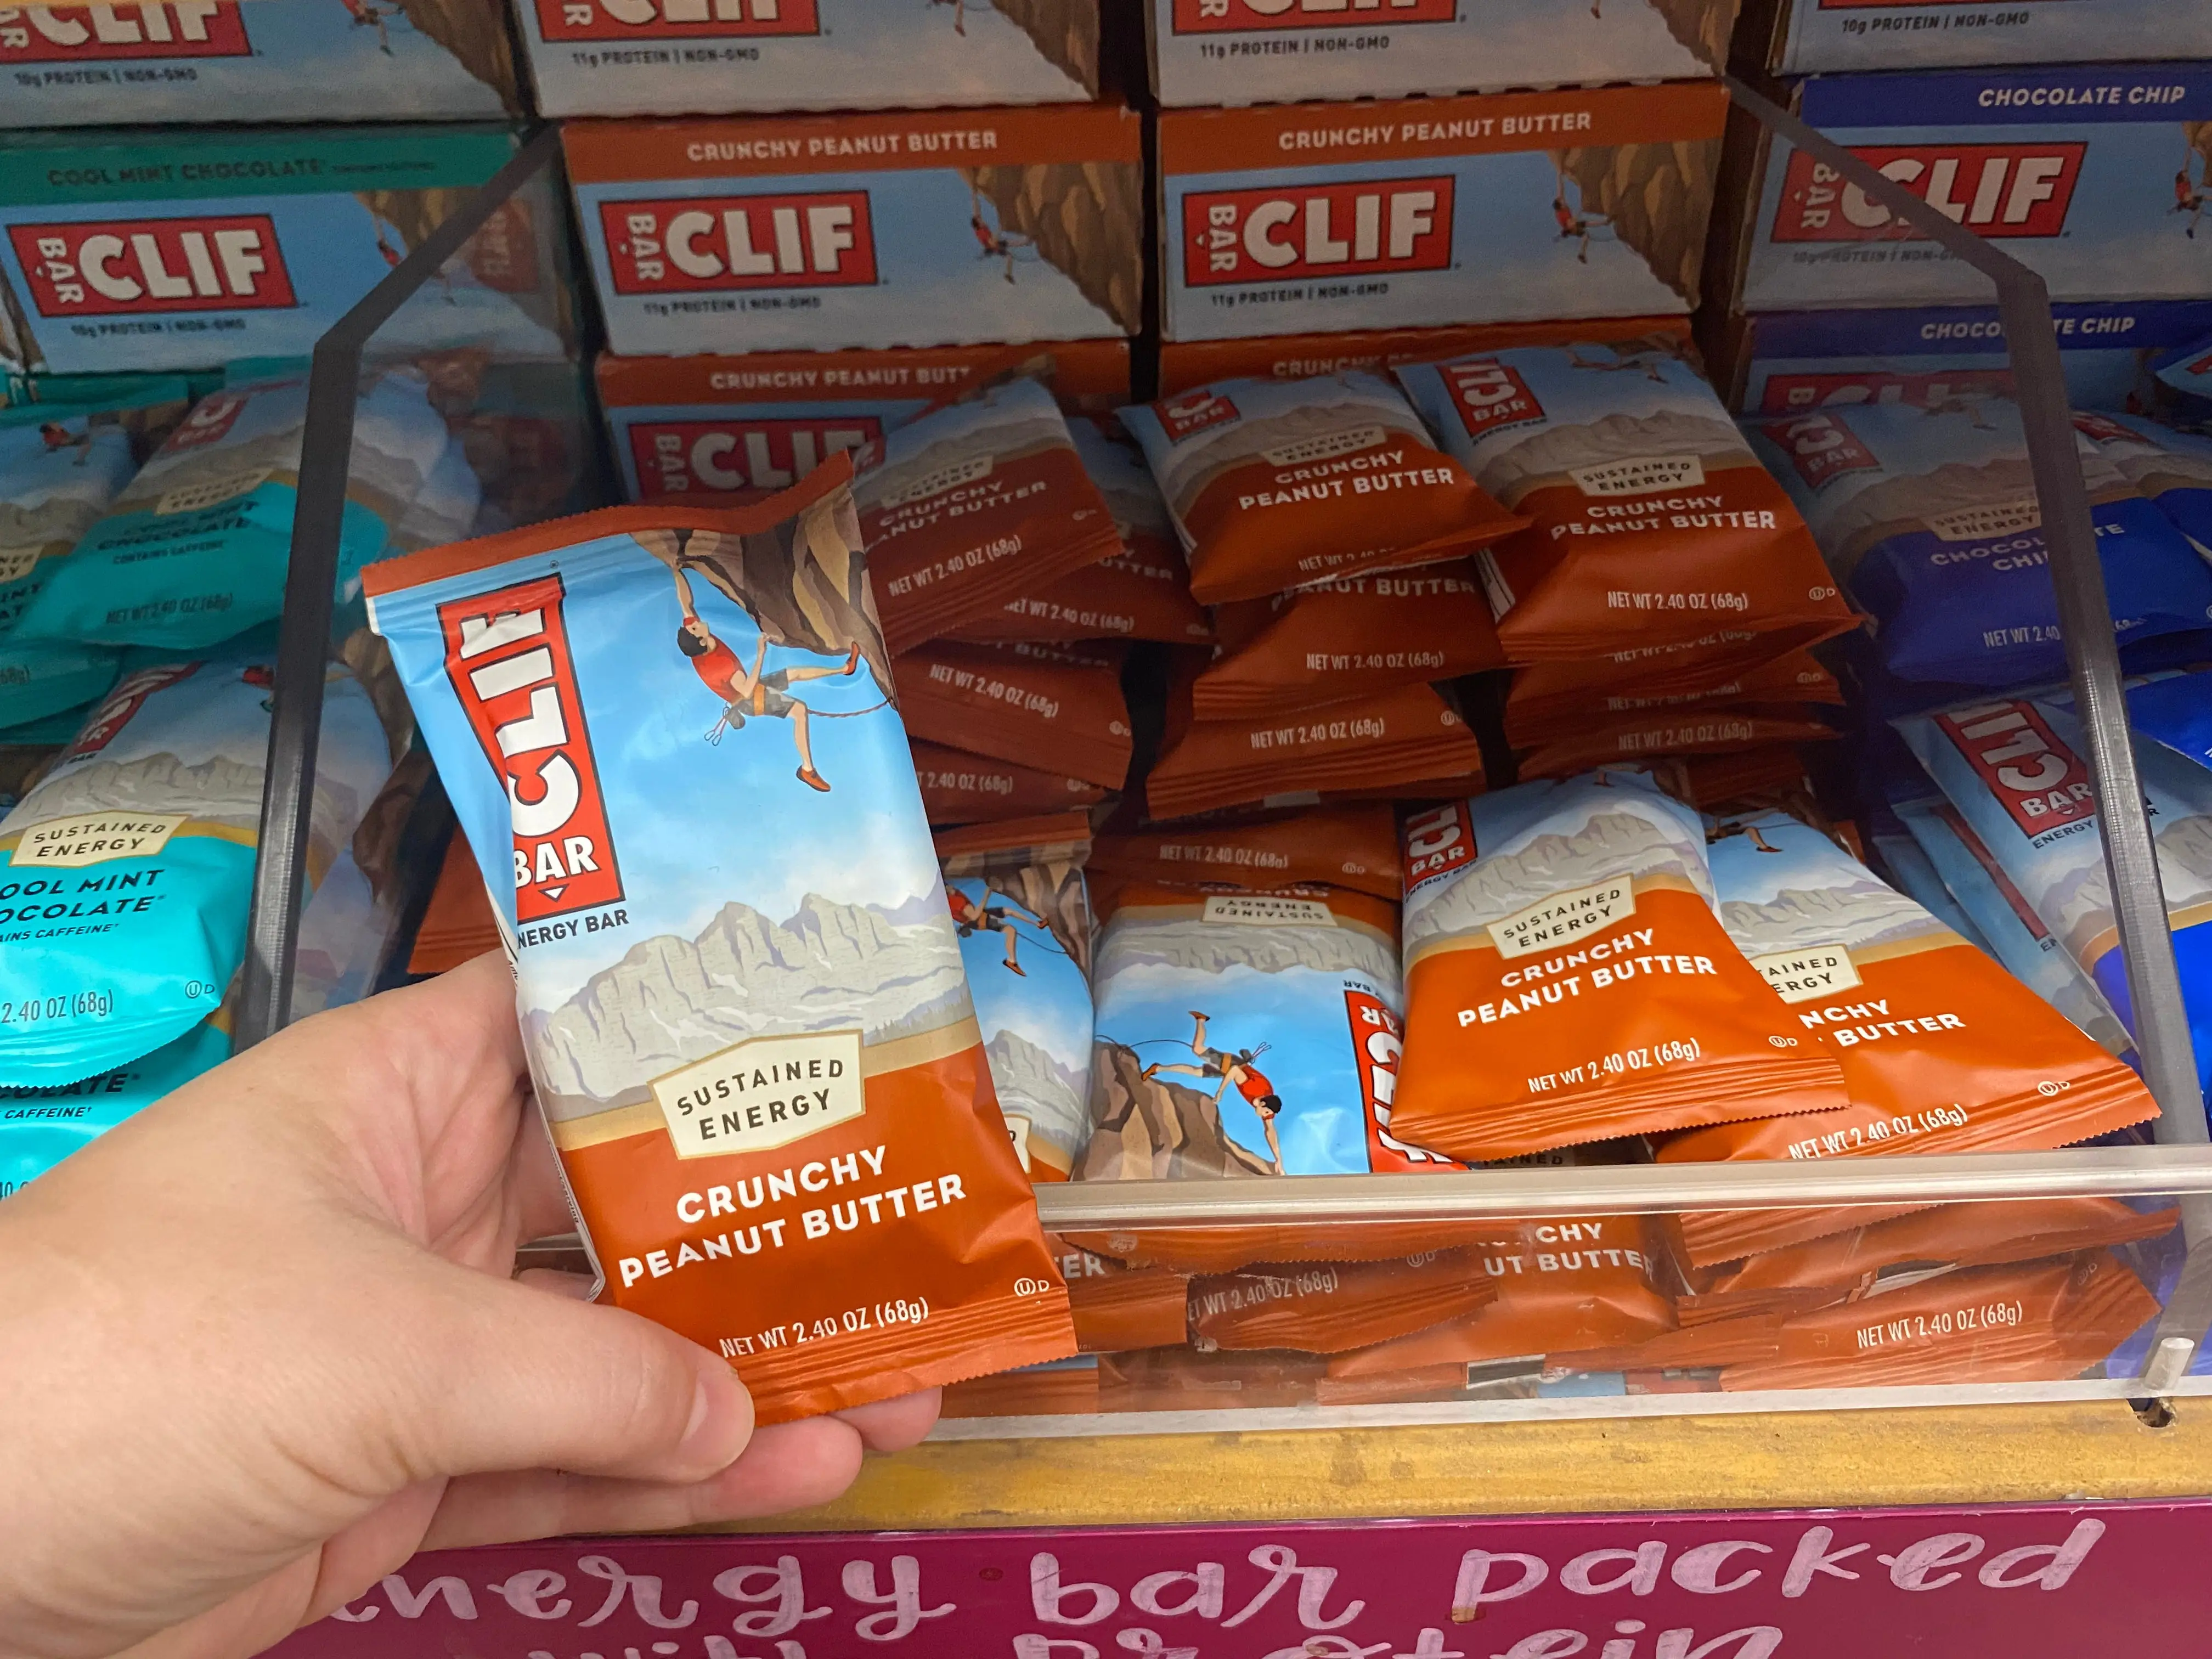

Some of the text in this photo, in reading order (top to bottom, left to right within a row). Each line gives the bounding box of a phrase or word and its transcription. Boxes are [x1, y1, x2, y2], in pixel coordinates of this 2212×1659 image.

[1842, 12, 2029, 34] 10g PROTEIN NON-GMO
[601, 49, 670, 65] PROTEIN
[684, 47, 760, 62] NON-GMO
[1200, 36, 1390, 60] 11g PROTEIN NON-GMO
[1978, 85, 2186, 108] CHOCOLATE CHIP
[687, 131, 997, 162] CRUNCHY PEANUT BUTTER
[1279, 112, 1592, 150] CRUNCHY PEANUT BUTTER
[48, 169, 112, 185] COOL
[119, 165, 172, 183] MINT
[181, 159, 320, 180] CHOCOLATE
[665, 205, 853, 278] CLIF
[1209, 205, 1237, 272] BAR
[1243, 190, 1437, 268] CLIF
[627, 213, 664, 281] BAR
[36, 237, 84, 303] BAR
[78, 229, 266, 301] CLIF
[672, 298, 736, 313] PROTEIN
[751, 296, 821, 309] NON-GMO
[1211, 284, 1389, 307] 11g PROTEIN NON-GMO
[2080, 315, 2136, 335] CHIP
[711, 367, 910, 390] CRUNCHY PEANUT
[1471, 399, 1527, 422] BAR
[657, 433, 690, 492] BAR
[1274, 450, 1404, 484] CRUNCHY
[1583, 461, 1690, 483] SUSTAINED
[1238, 467, 1454, 510] PEANUT BUTTER
[1598, 472, 1683, 491] ENERGY
[879, 479, 1005, 527] CRUNCHY
[949, 481, 1047, 517] BUTTER
[1587, 495, 1723, 518] CRUNCHY
[1550, 510, 1776, 540] PEANUT BUTTER
[1950, 516, 2034, 535] ENERGY
[888, 534, 1023, 597] NET WT 2.40 OZ (68g)
[1375, 578, 1475, 597] BUTTER
[1608, 591, 1748, 611] NET WT 2.40 OZ (68g)
[1029, 601, 1048, 618] WT
[1051, 605, 1078, 623] 2.40
[1080, 611, 1097, 627] OZ
[1983, 625, 2061, 648] NET WT 2.40
[1306, 650, 1445, 670] NET WT 2.40 OZ (68g)
[929, 663, 1059, 719] NET WT 2.40 OZ (68g)
[460, 607, 583, 837] CLIF
[1250, 718, 1386, 749] NET WT 2.40 OZ (68g)
[1619, 733, 1640, 751] NET
[1644, 730, 1662, 748] WT
[1697, 724, 1714, 742] OZ
[928, 772, 955, 790] 2.40
[958, 775, 974, 790] OZ
[979, 774, 1013, 795] (68g)
[2019, 783, 2093, 818] BAR
[34, 822, 166, 844] SUSTAINED
[36, 837, 146, 857] ENERGY
[2032, 820, 2094, 849] ENERGY
[515, 834, 600, 887] BAR
[1160, 845, 1252, 864] NET WT 2.40 OZ
[1410, 847, 1465, 877] BAR
[0, 869, 165, 900] OOL MINT
[1215, 905, 1323, 919] SUSTAINED
[1226, 899, 1311, 911] ENERGY
[1503, 888, 1621, 939] SUSTAINED
[517, 909, 630, 950] NERGY BAR
[1518, 905, 1613, 949] ENERGY
[1499, 928, 1654, 988] CRUNCHY
[1, 988, 113, 1024] 2.40 OZ (68g)
[1457, 955, 1717, 1028] PEANUT BUTTER
[1833, 1013, 1967, 1047] BUTTER
[1527, 1037, 1701, 1093] NET WT 2.40 OZ (68g)
[676, 1058, 845, 1116] SUSTAINED
[698, 1088, 832, 1141] ENERGY
[1788, 1103, 1968, 1159] NET WT 2.40 OZ (68g)
[676, 1144, 888, 1224] CRUNCHY
[618, 1173, 967, 1288] PEANUT BUTTER
[1203, 1290, 1227, 1316] WT
[1231, 1284, 1263, 1311] 2.40
[1296, 1267, 1339, 1298] (68g)
[719, 1297, 930, 1359] NET WT 2.40 OZ (68g)
[1857, 1300, 2023, 1349] NET WT 2.40 OZ (68g)
[1030, 1544, 1365, 1630] bar
[1451, 1518, 2106, 1624] packed
